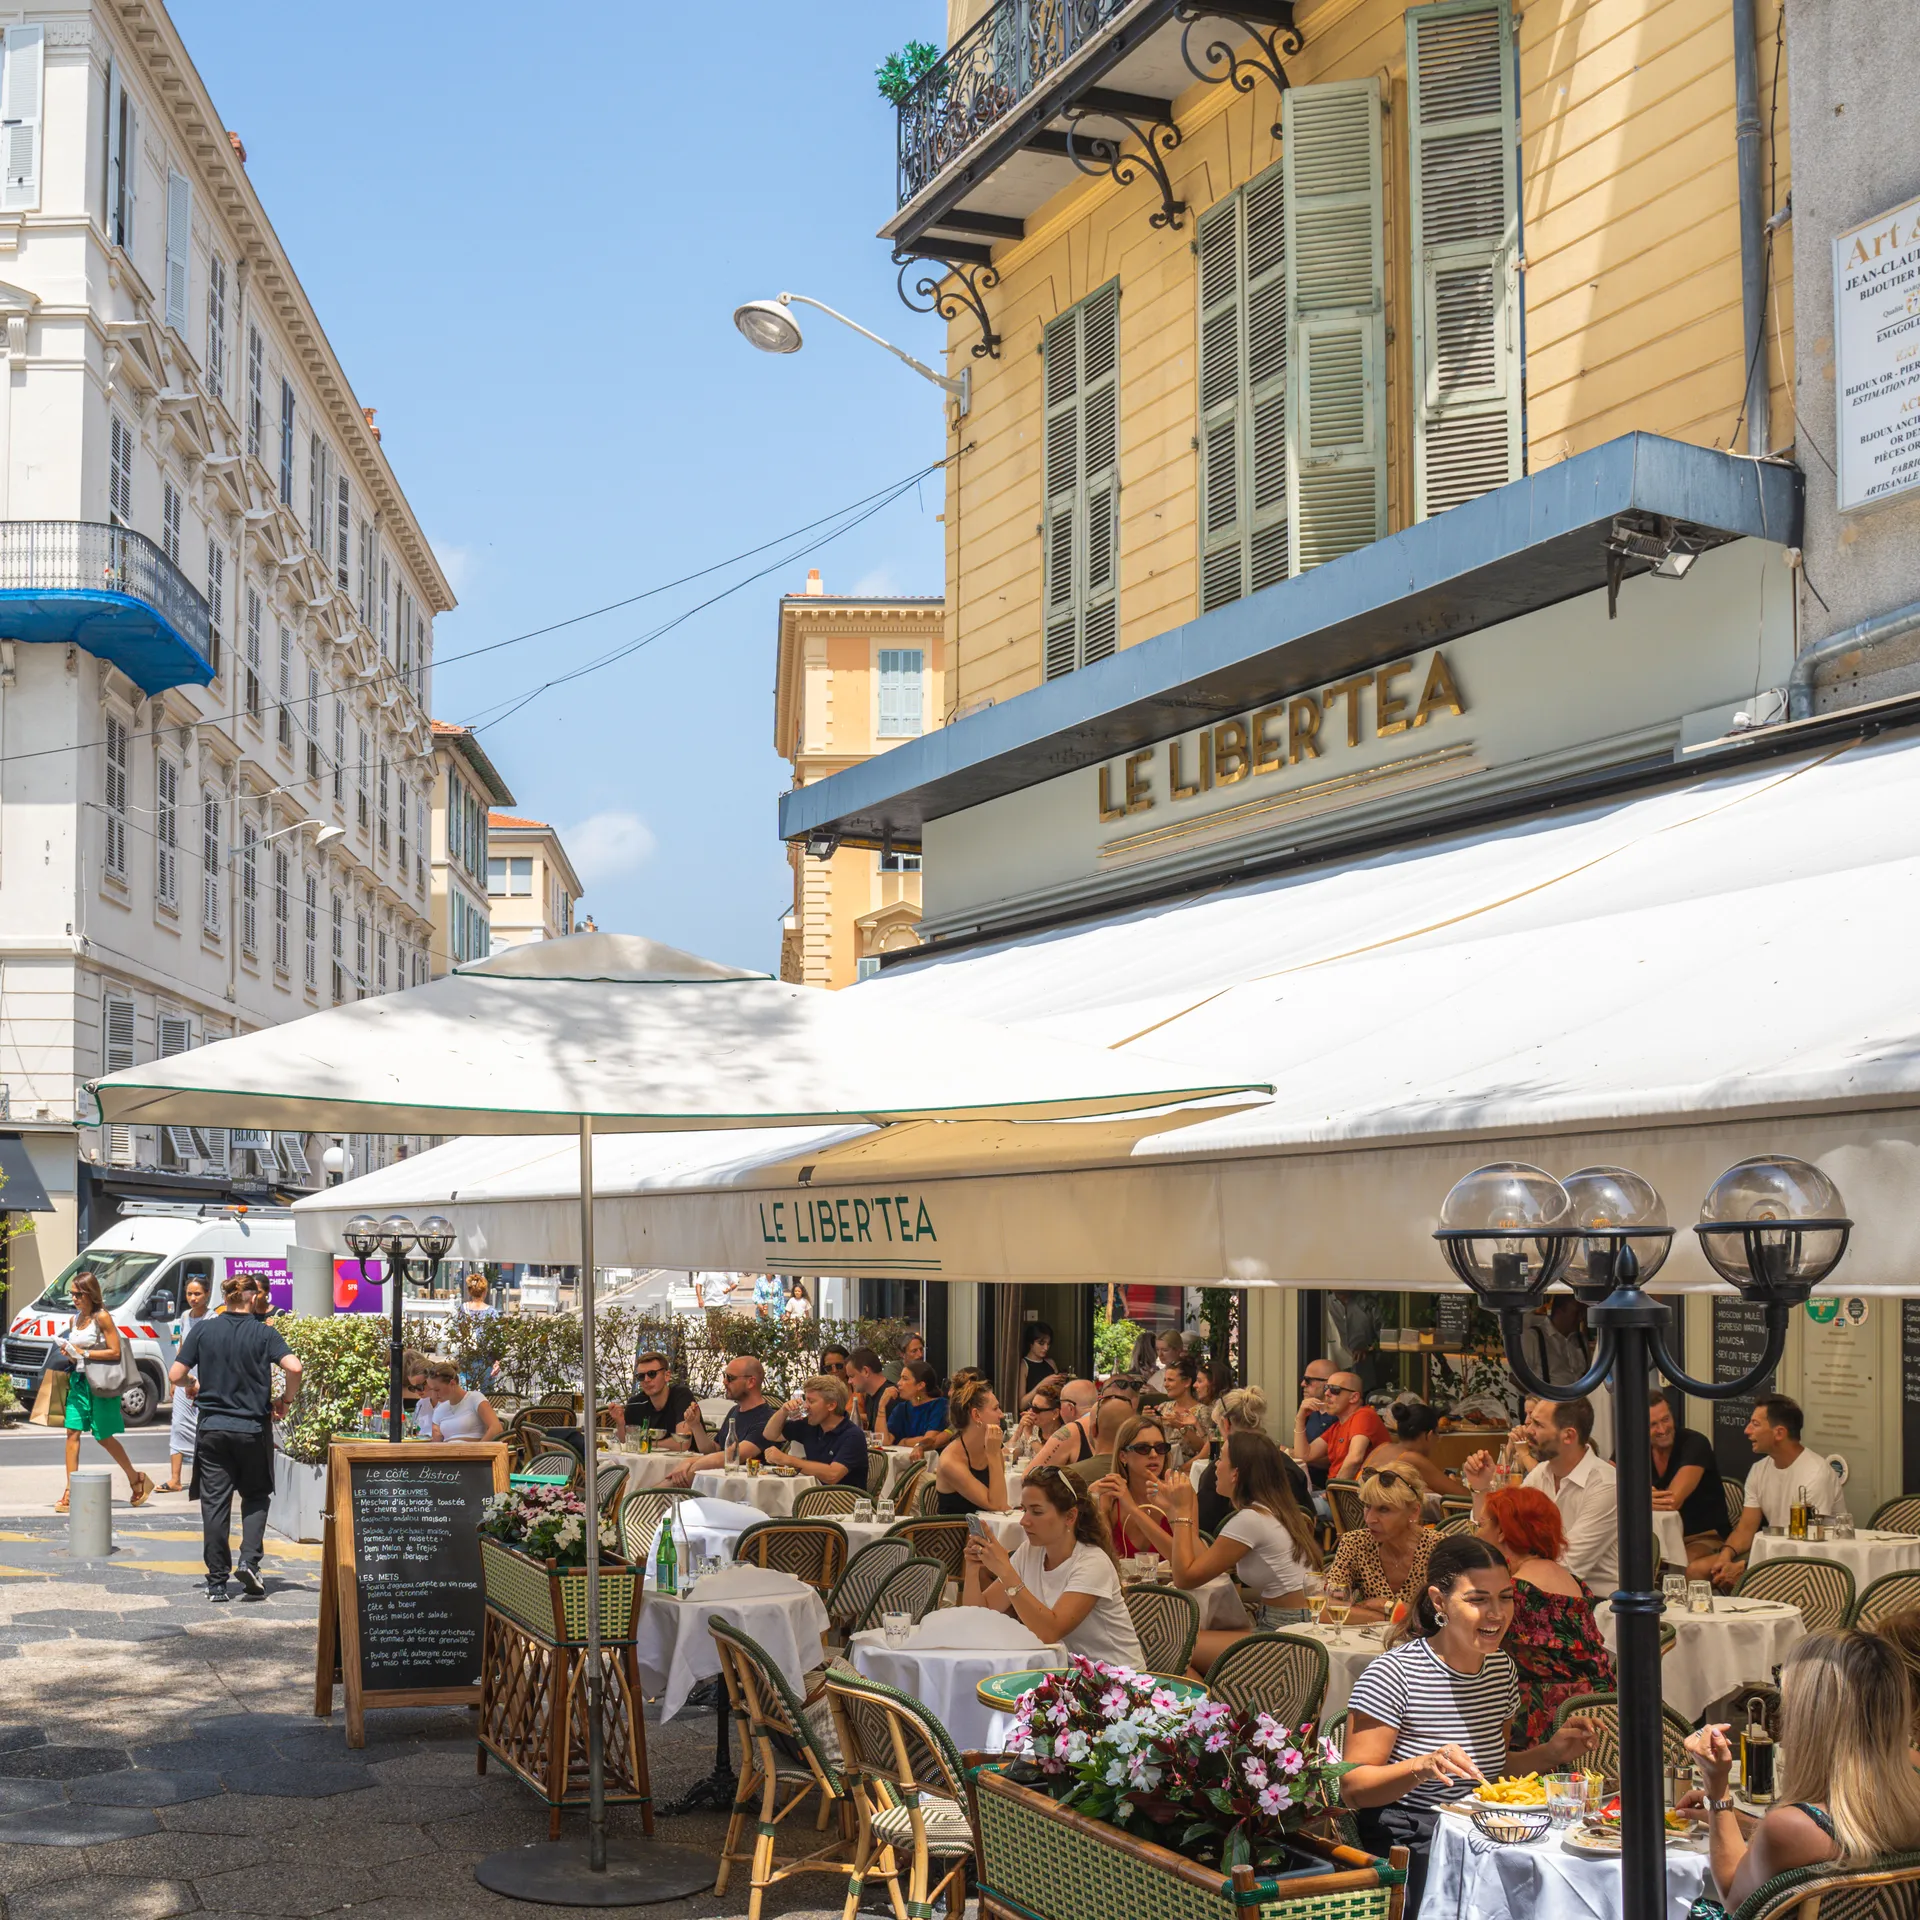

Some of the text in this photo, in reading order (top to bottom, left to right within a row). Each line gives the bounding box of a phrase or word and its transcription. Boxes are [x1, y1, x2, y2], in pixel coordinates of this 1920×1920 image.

[1845, 220, 1901, 271] Art
[1860, 269, 1915, 301] BIJOUTIER
[1845, 377, 1878, 397] BIJOUX
[1879, 372, 1893, 384] OR
[1852, 378, 1906, 407] ESTIMATION
[1860, 425, 1894, 445] BIJOUX
[1890, 434, 1904, 446] OR
[1874, 446, 1906, 465] PIÈCES
[1864, 470, 1919, 497] ARTISANALE
[1098, 650, 1465, 824] LE LIBER'TEA
[234, 1129, 269, 1143] BIJOUX
[760, 1196, 938, 1243] LE LIBER'TEA
[347, 1283, 358, 1291] SFR
[1744, 1311, 1761, 1320] MULE
[1718, 1322, 1742, 1332] ESPRESSO
[1719, 1336, 1745, 1346] MIMOSA
[1718, 1350, 1728, 1359] SEX
[1728, 1351, 1737, 1360] ON
[1738, 1352, 1750, 1362] THE
[1718, 1365, 1741, 1376] FRENCH
[1720, 1415, 1746, 1427] MOJITO
[366, 1466, 461, 1480] Le côté Bistrot
[353, 1488, 367, 1497] LES
[369, 1488, 389, 1496] HORS
[360, 1498, 389, 1506] Mesclun
[409, 1498, 434, 1506] brioche
[437, 1497, 466, 1506] toastée
[363, 1534, 439, 1544] parmesan et noisette
[364, 1545, 380, 1553] Demi
[381, 1544, 402, 1552] Melon
[406, 1543, 413, 1552] de
[364, 1553, 372, 1561] et
[375, 1553, 399, 1562] jambon
[359, 1573, 400, 1582] LES METS
[366, 1583, 385, 1591] Souris
[415, 1580, 438, 1588] confite
[458, 1581, 478, 1590] rouge
[368, 1588, 429, 1599] polenta citronnée
[367, 1602, 384, 1611] Côte
[388, 1601, 395, 1609] de
[369, 1611, 449, 1622] Frites maison et salade
[369, 1627, 399, 1636] Calamars
[402, 1626, 427, 1635] sautés
[440, 1628, 476, 1636] artichauts
[380, 1635, 405, 1644] pommes
[370, 1651, 390, 1660] Poulpe
[410, 1649, 440, 1659] aubergine
[442, 1650, 468, 1659] confite
[371, 1661, 380, 1669] au
[435, 1659, 456, 1667] vierge
